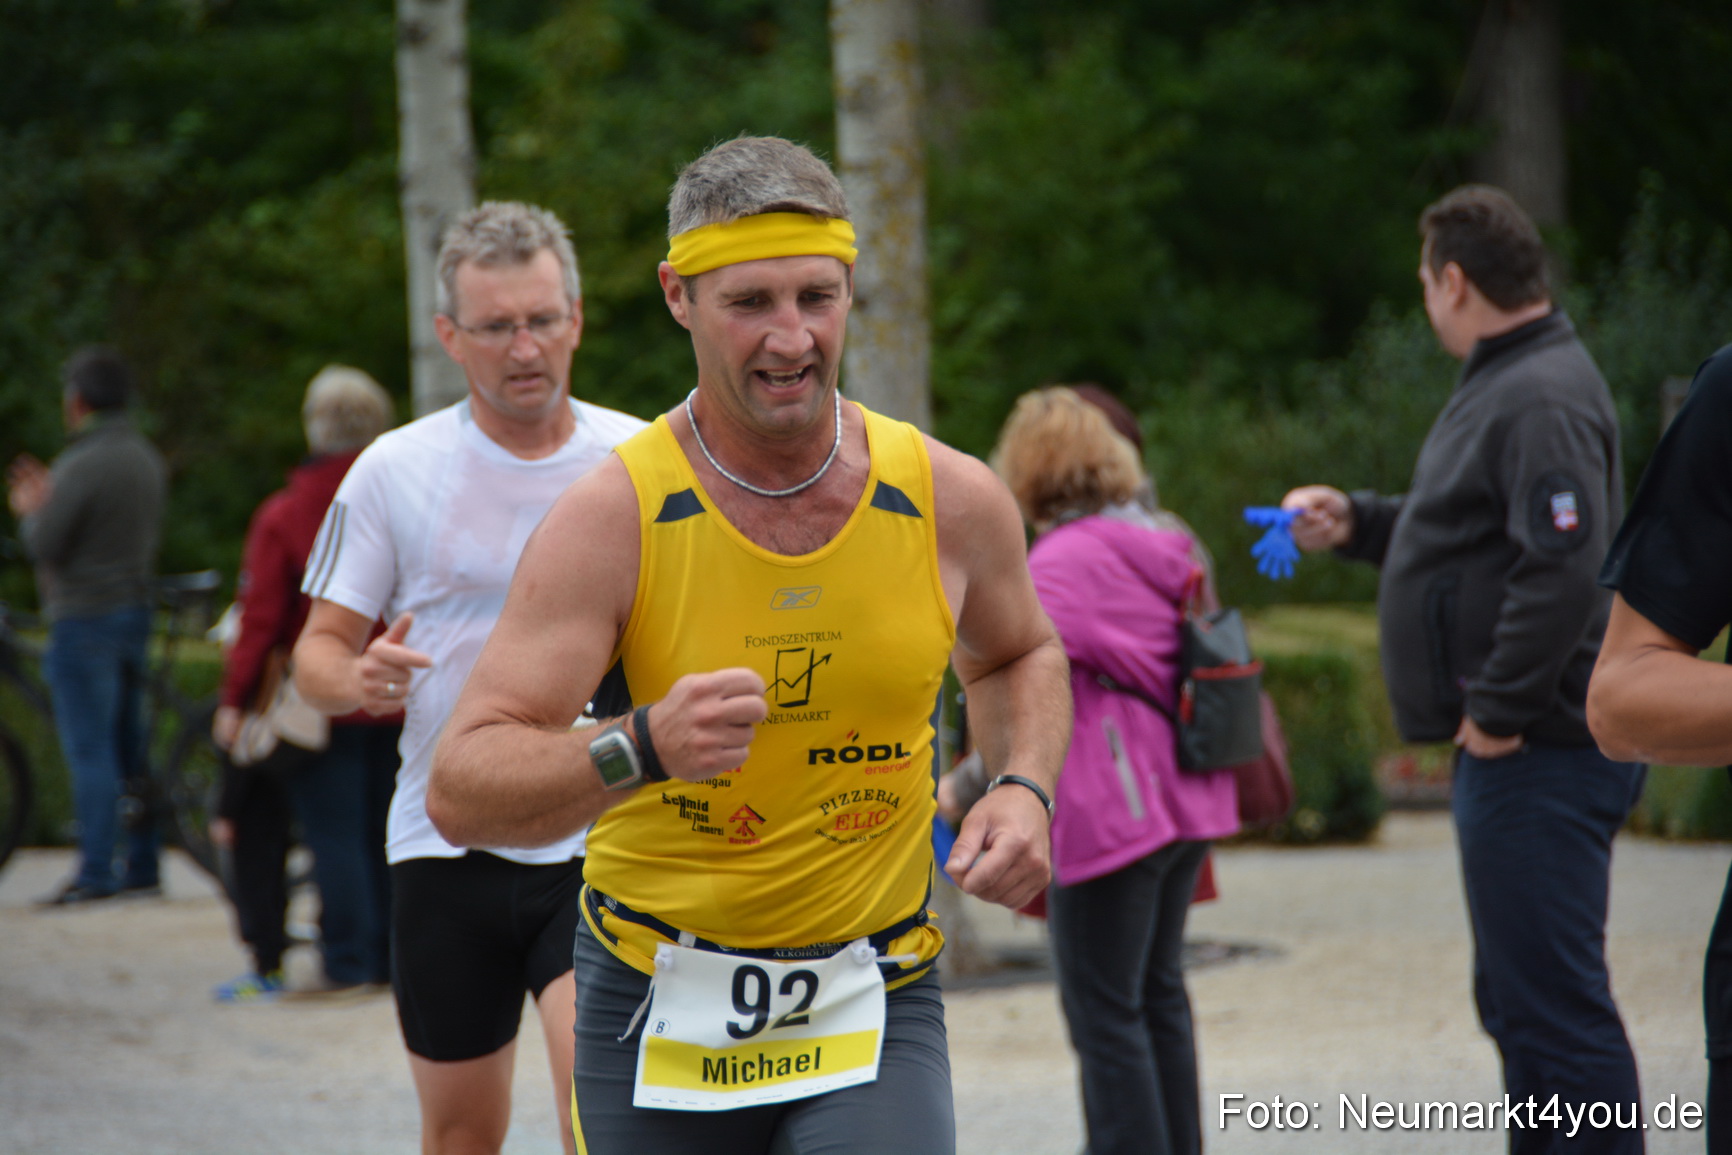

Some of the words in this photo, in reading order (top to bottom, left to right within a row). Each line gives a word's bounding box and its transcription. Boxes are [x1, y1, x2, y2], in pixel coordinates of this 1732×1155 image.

[762, 710, 831, 725] NEUMARKT
[819, 789, 900, 816] PIZZERIA
[833, 809, 890, 831] ELIO
[726, 964, 819, 1040] 92
[702, 1047, 821, 1085] Michael
